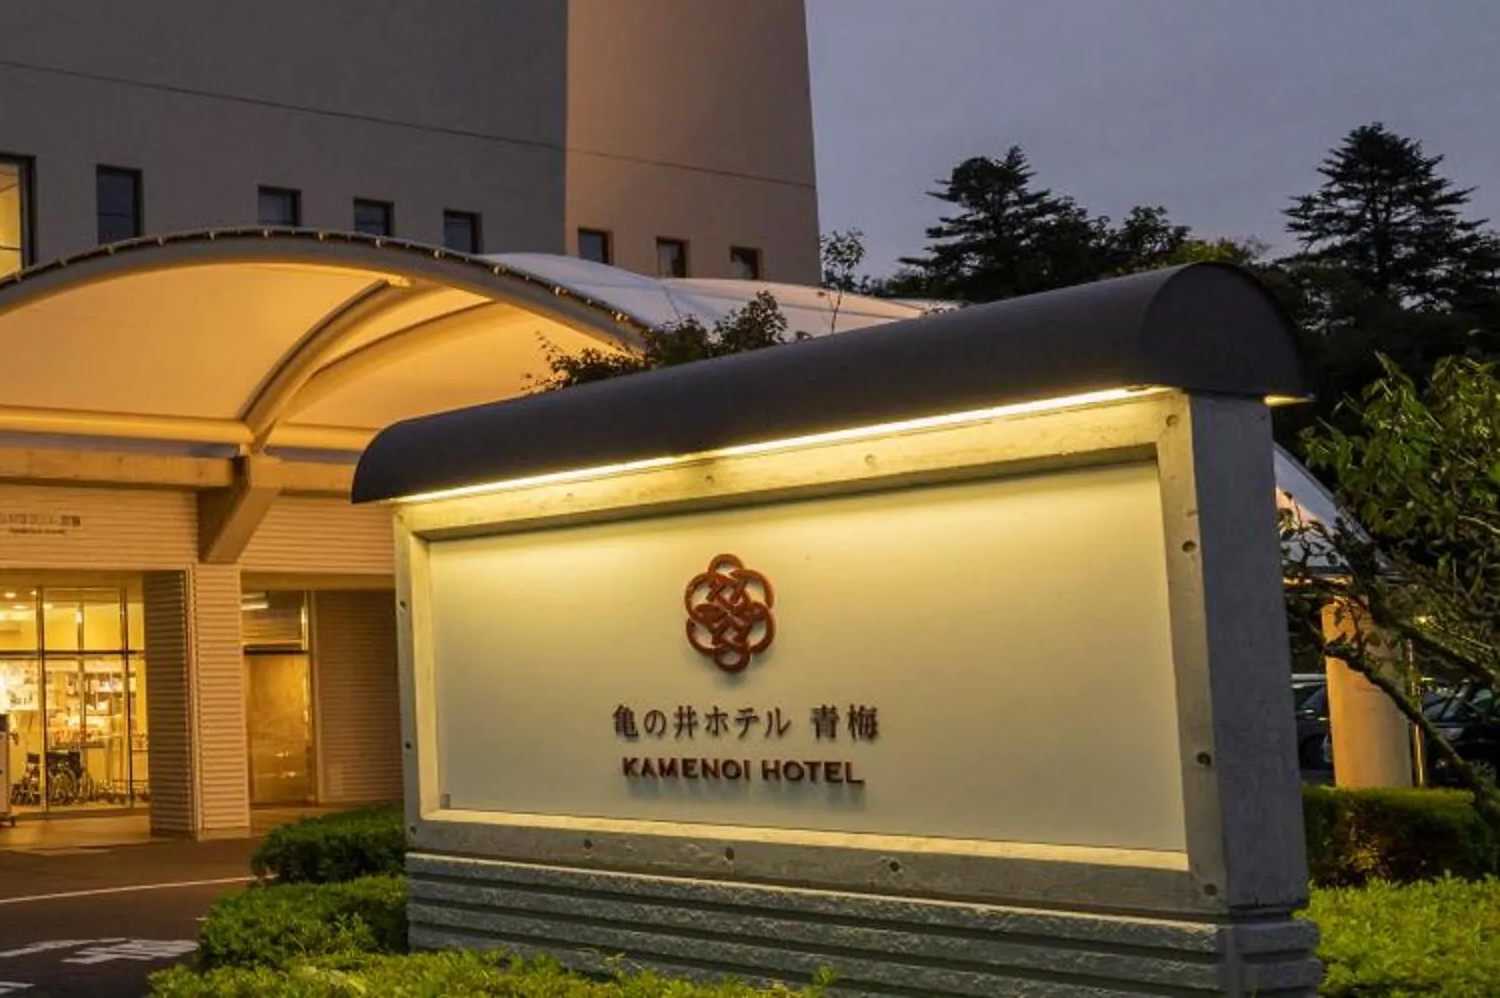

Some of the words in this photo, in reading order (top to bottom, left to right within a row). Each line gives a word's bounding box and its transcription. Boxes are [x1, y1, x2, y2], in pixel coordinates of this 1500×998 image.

[611, 704, 793, 742] 亀の井ホテル
[809, 704, 881, 742] 青梅
[621, 757, 751, 781] KAMENOI
[760, 759, 866, 786] HOTEL
